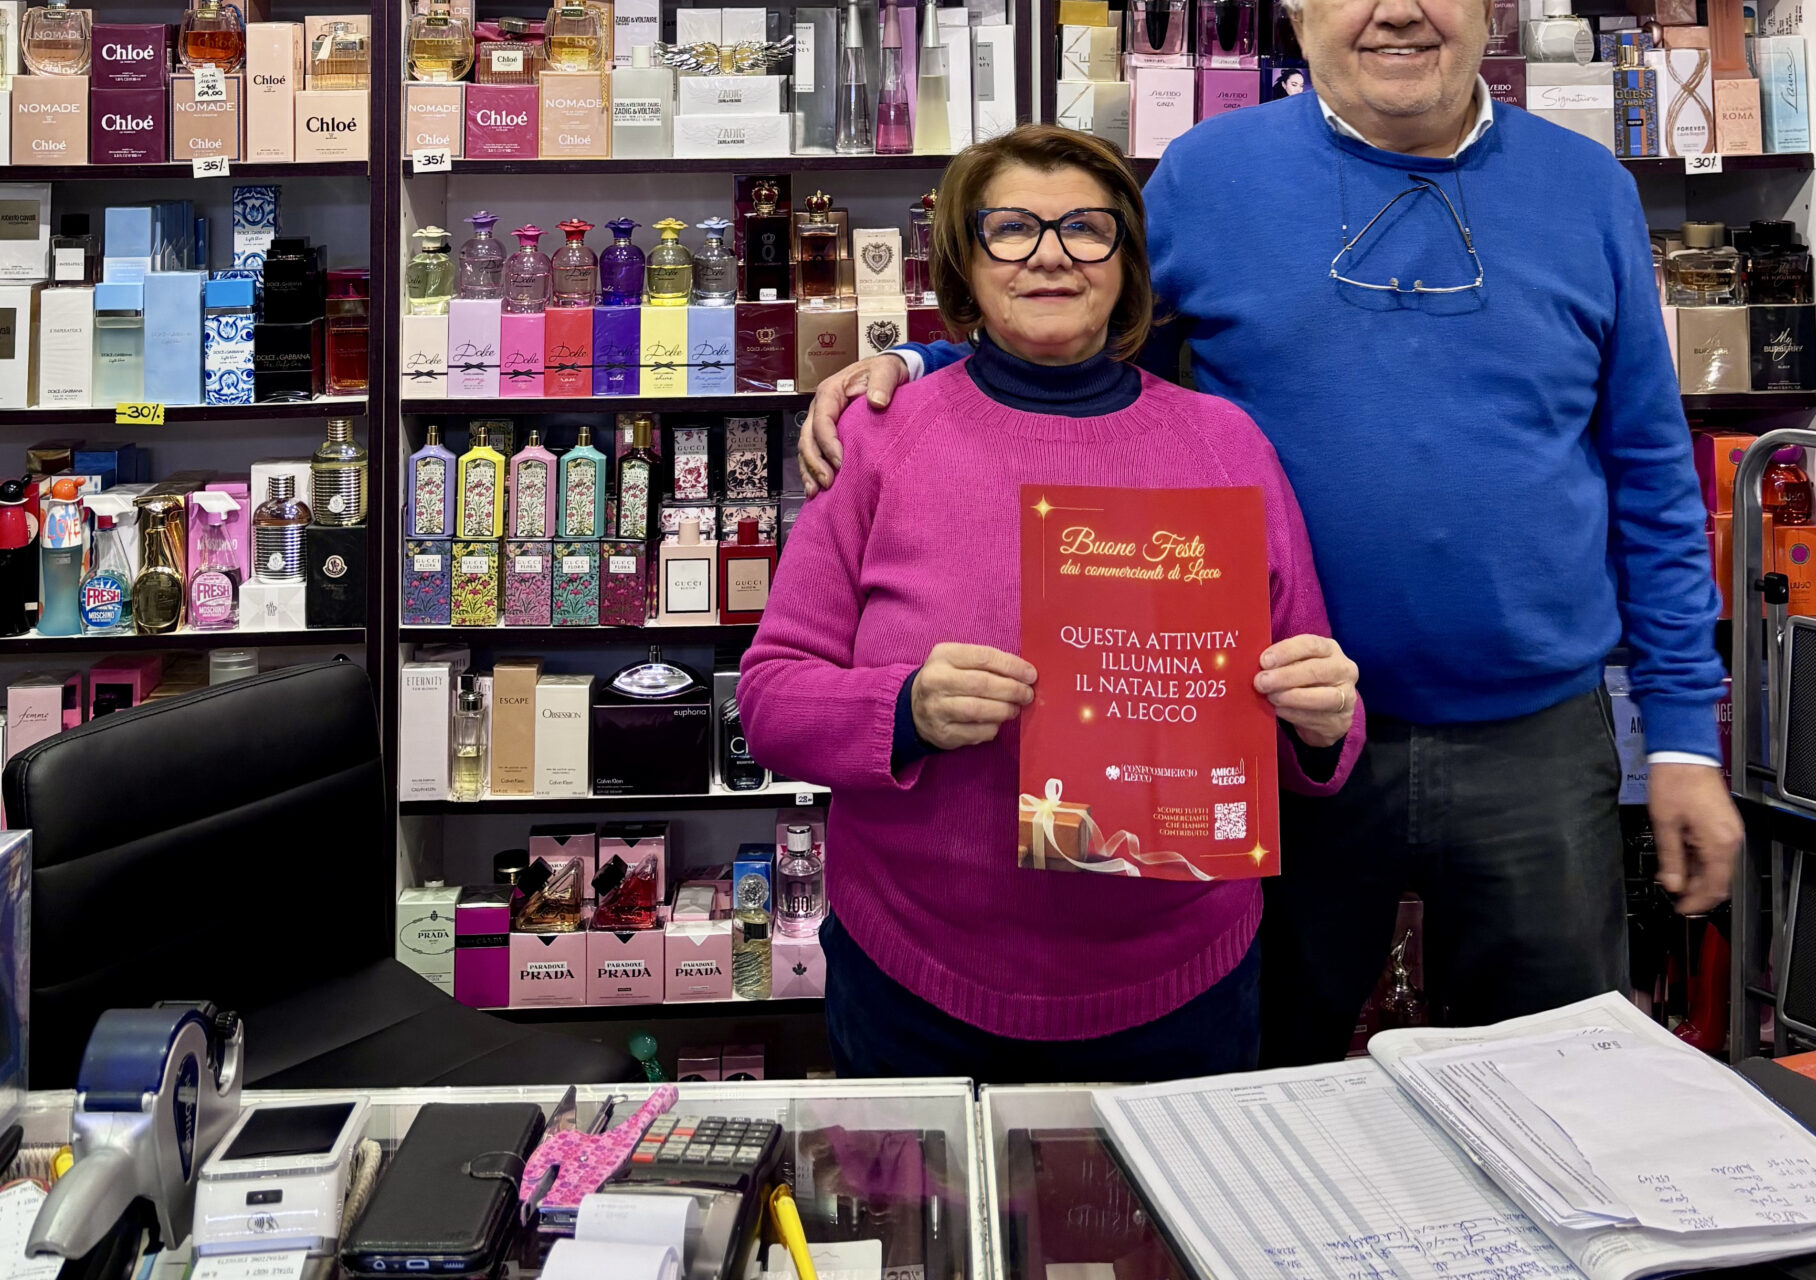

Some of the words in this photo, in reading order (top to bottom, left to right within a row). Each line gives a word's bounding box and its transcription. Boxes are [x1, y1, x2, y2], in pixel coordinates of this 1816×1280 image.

[102, 43, 154, 60] Chloé
[497, 55, 518, 63] Chloé
[253, 74, 286, 86] Chloé
[718, 89, 742, 99] ZADIG
[1615, 88, 1653, 99] GUESS
[19, 103, 80, 113] NOMADE
[176, 102, 234, 112] NOMADE
[409, 105, 459, 113] NOMADE
[476, 111, 528, 126] Chloé
[1722, 112, 1754, 120] ROMA
[102, 114, 153, 131] Chloé
[306, 117, 356, 132] Chloé
[416, 134, 449, 144] Chloé
[559, 134, 591, 144] Chloé
[717, 128, 745, 138] ZADIG
[32, 139, 67, 150] Chloé
[189, 138, 222, 150] Chloé
[198, 158, 225, 171] -35%
[417, 153, 445, 165] -35%
[1688, 154, 1716, 169] -30%
[762, 245, 775, 261] Q
[453, 340, 495, 361] Dolce
[692, 340, 729, 360] Dolce
[410, 350, 443, 368] Dolce
[116, 406, 161, 419] -30%
[1060, 526, 1136, 556] Buone
[1143, 530, 1205, 562] Feste
[1060, 560, 1080, 575] dai
[1085, 563, 1164, 579] commercianti
[1168, 567, 1181, 579] di
[1184, 558, 1221, 585] Lecco
[86, 590, 120, 607] FRESH
[196, 583, 230, 602] FRESH
[88, 611, 114, 620] MOSCHINO
[1060, 626, 1140, 648] QUESTA
[1146, 630, 1239, 650] ATTIVITA'
[1102, 653, 1202, 674] ILLUMINA
[406, 676, 443, 687] ETERNITY
[1076, 674, 1092, 691] IL
[1098, 676, 1179, 698] NATALE
[1185, 680, 1226, 698] 2025
[499, 697, 529, 705] ESCAPE
[542, 708, 582, 720] OBSESSION
[673, 708, 707, 718] euphoria
[1106, 701, 1121, 717] A
[1127, 702, 1196, 722] LECCO
[1123, 765, 1197, 778] CONFCOMMERCIO
[1211, 768, 1234, 777] AMICI
[1219, 776, 1245, 785] LECCO
[418, 931, 449, 939] PRADA
[606, 961, 644, 969] PARADOXE
[520, 968, 575, 981] PRADA
[597, 967, 652, 979] PRADA
[675, 966, 722, 977] PRADA
